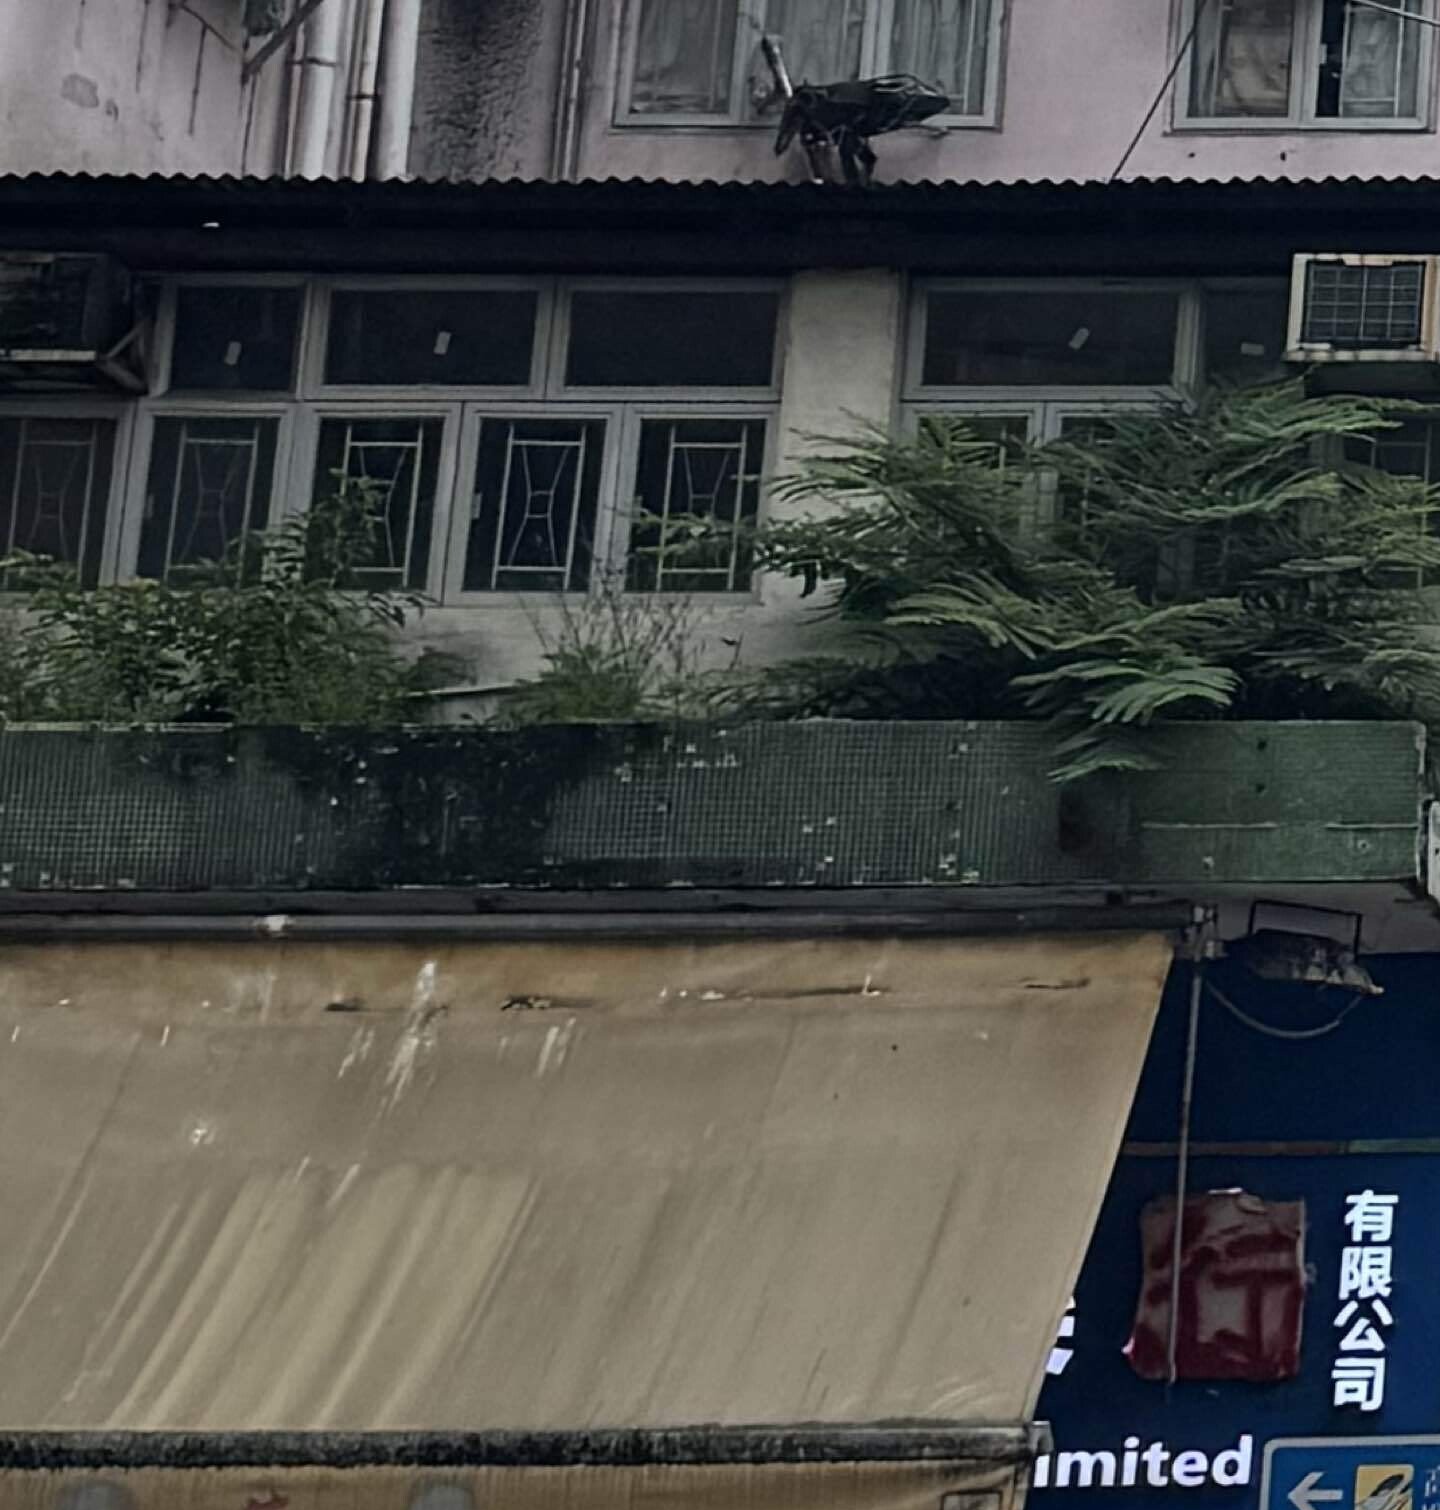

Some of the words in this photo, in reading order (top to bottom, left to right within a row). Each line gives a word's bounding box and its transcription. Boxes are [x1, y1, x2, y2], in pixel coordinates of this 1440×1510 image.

[1330, 1189, 1399, 1413] 有限公司
[1033, 1434, 1254, 1488] imited
